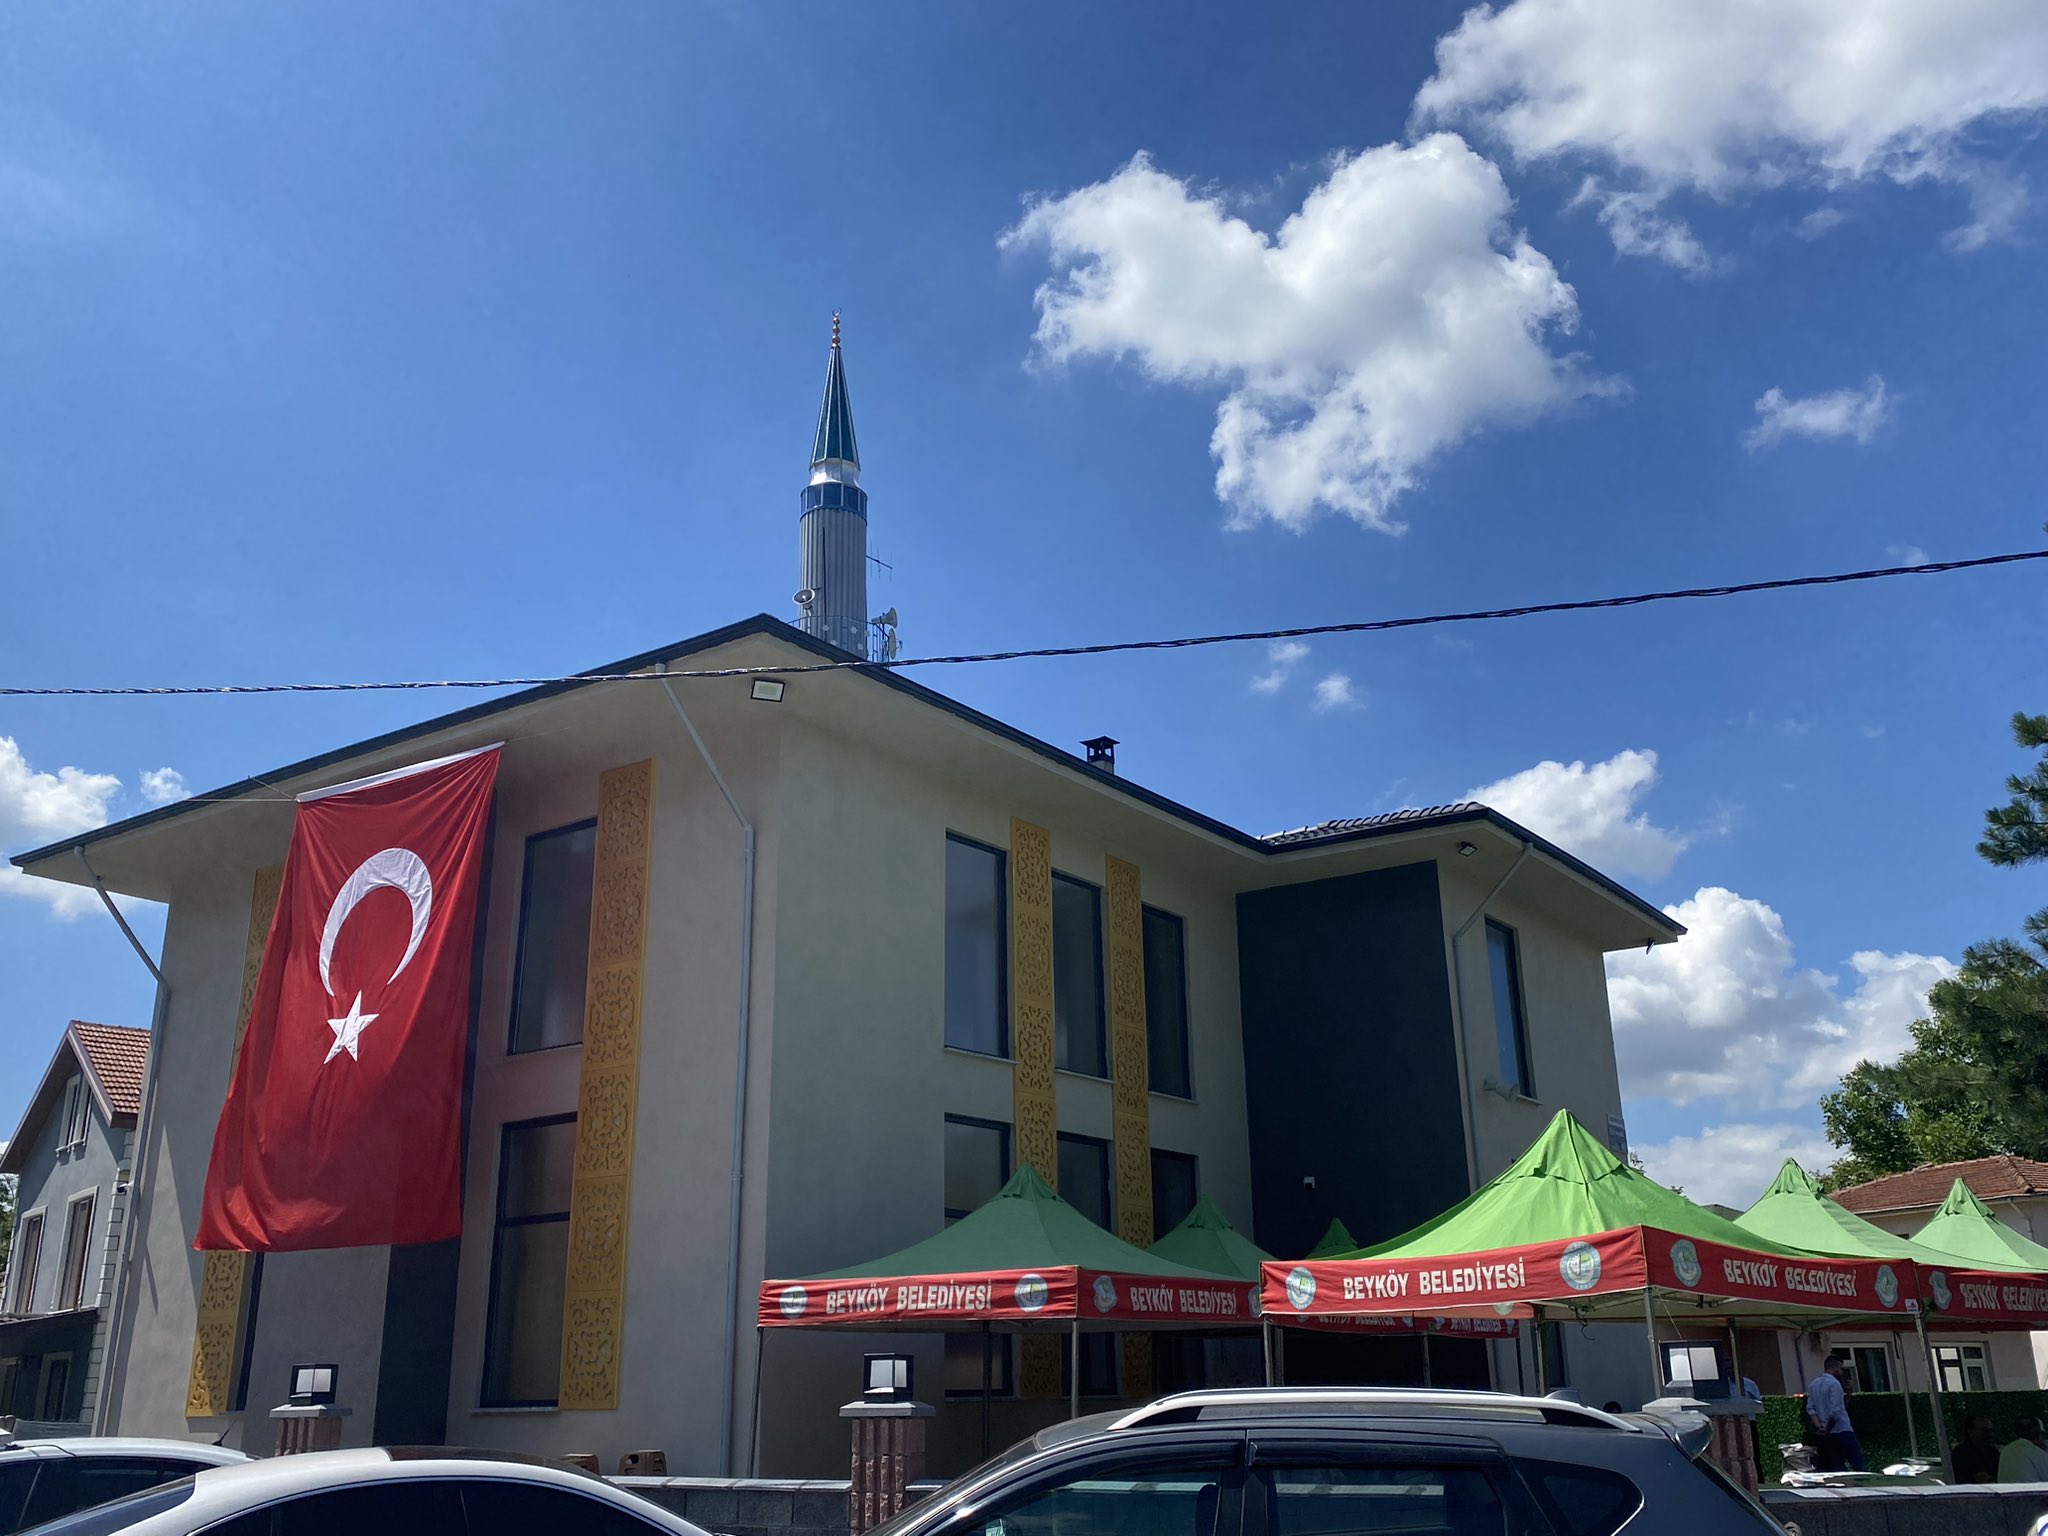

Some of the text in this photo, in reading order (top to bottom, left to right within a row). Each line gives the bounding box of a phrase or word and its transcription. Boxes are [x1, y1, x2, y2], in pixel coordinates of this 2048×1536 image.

[1343, 1269, 1409, 1300] BEYKÖY
[1419, 1257, 1526, 1295] BELEDİYESİ
[1723, 1259, 1778, 1288] BEYKÖY
[1785, 1266, 1857, 1297] BELEDİYESİ
[1960, 1280, 2001, 1310] BEYKÖY
[826, 1283, 889, 1314] BEYKÖY
[896, 1279, 992, 1310] BELEDİYESİ
[1130, 1284, 1237, 1315] BEYKÖY BELEDİYESİ
